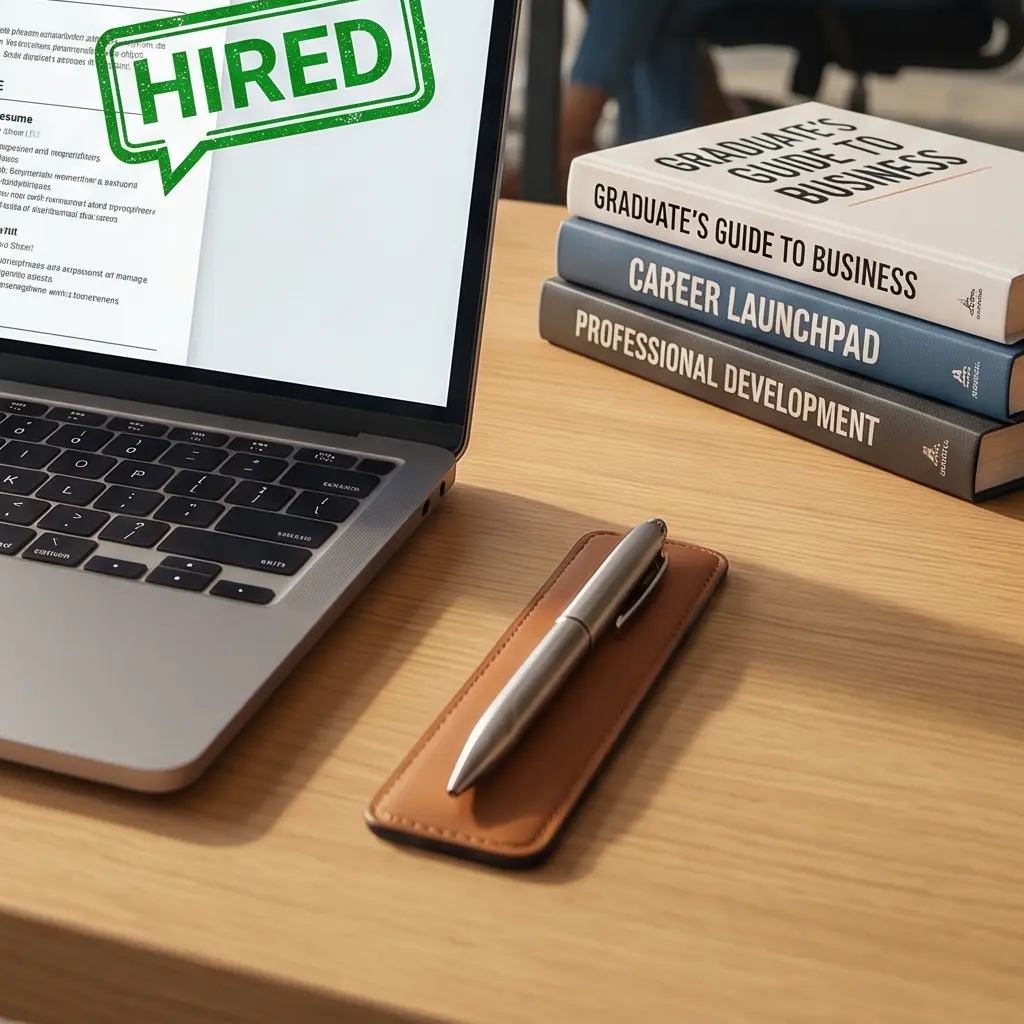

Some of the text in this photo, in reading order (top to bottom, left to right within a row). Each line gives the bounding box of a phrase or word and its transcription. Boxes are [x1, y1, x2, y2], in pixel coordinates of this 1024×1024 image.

[132, 17, 392, 125] HIRED
[654, 117, 857, 173] GRADUATE'S
[727, 135, 905, 185] GUIDE TO
[773, 149, 968, 205] BUSINESS
[594, 183, 918, 300] GRADUATE'S GUIDE TO BUSINESS
[629, 256, 721, 316] CAREER
[727, 287, 880, 366] LAUNCHPAD
[575, 309, 717, 390] PROFESSIONAL
[723, 363, 880, 447] DEVELOPMENT
[3, 475, 19, 484] K
[62, 486, 72, 494] L
[131, 470, 145, 478] P
